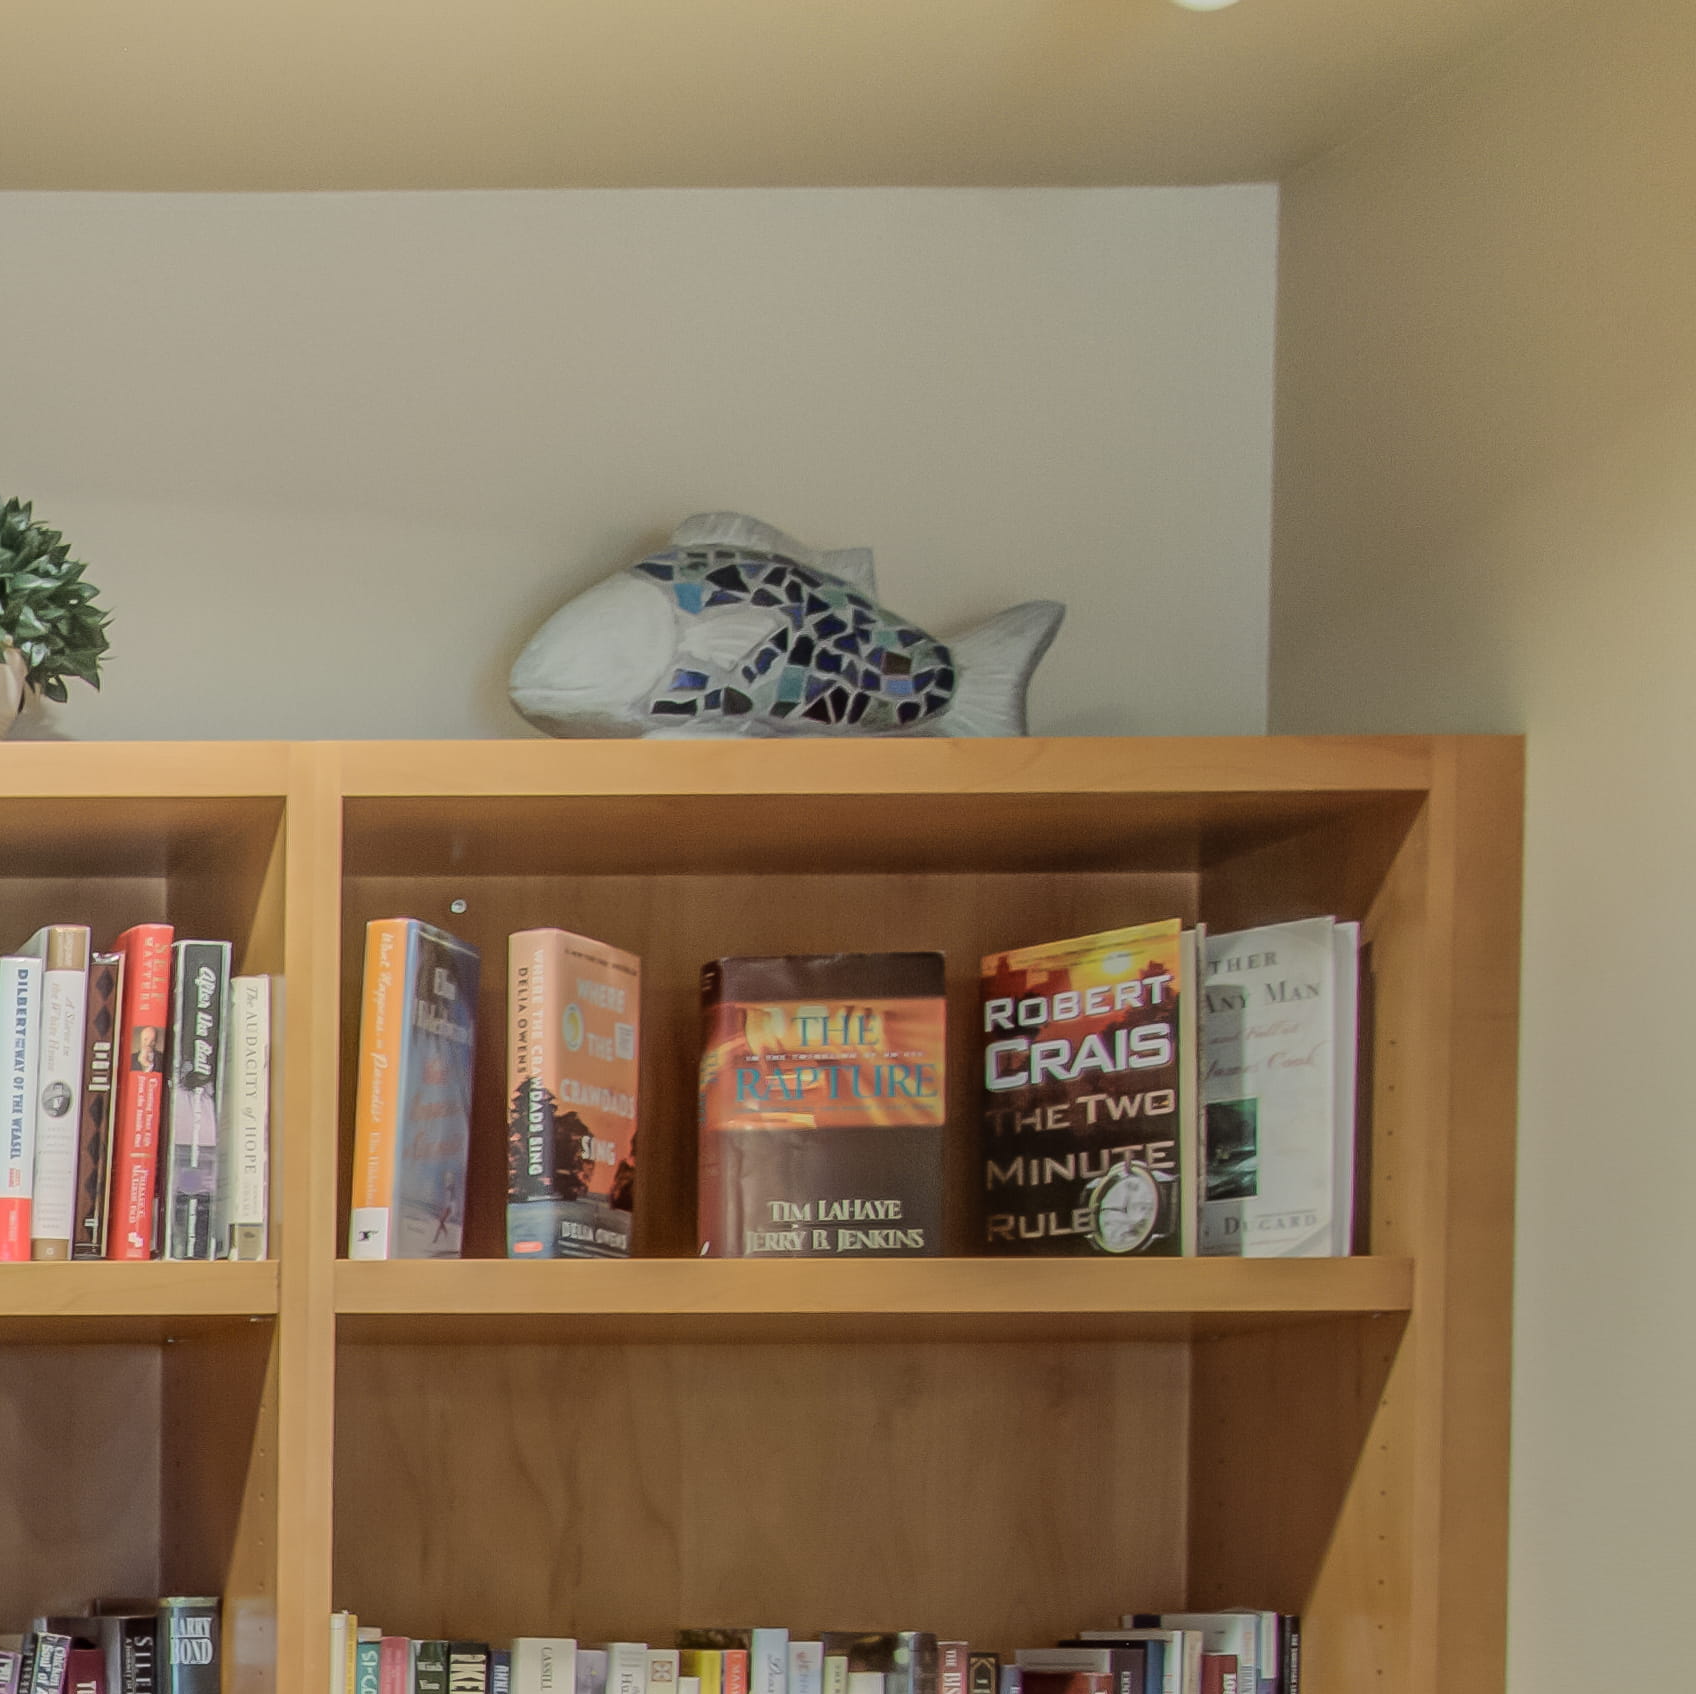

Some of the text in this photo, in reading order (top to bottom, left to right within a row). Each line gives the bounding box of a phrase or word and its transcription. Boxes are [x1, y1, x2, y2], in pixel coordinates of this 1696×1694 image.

[516, 967, 528, 1073] DELIA OWENS
[984, 974, 1173, 1032] ROBERT
[792, 1015, 879, 1047] THE
[10, 969, 29, 1159] DILBERT WAY OF THE WEASEL
[528, 948, 545, 1176] WHERE THE CRAWDADS SING
[985, 1023, 1173, 1092] CRAIS
[735, 1063, 938, 1102] RAPTURE
[985, 1089, 1175, 1135] THE TWO
[985, 1141, 1175, 1191] MINUTE
[769, 1199, 902, 1222] TIM LAHAYE
[986, 1208, 1097, 1242] RULE
[745, 1231, 807, 1254] JERRY
[837, 1229, 925, 1252] JENKINS
